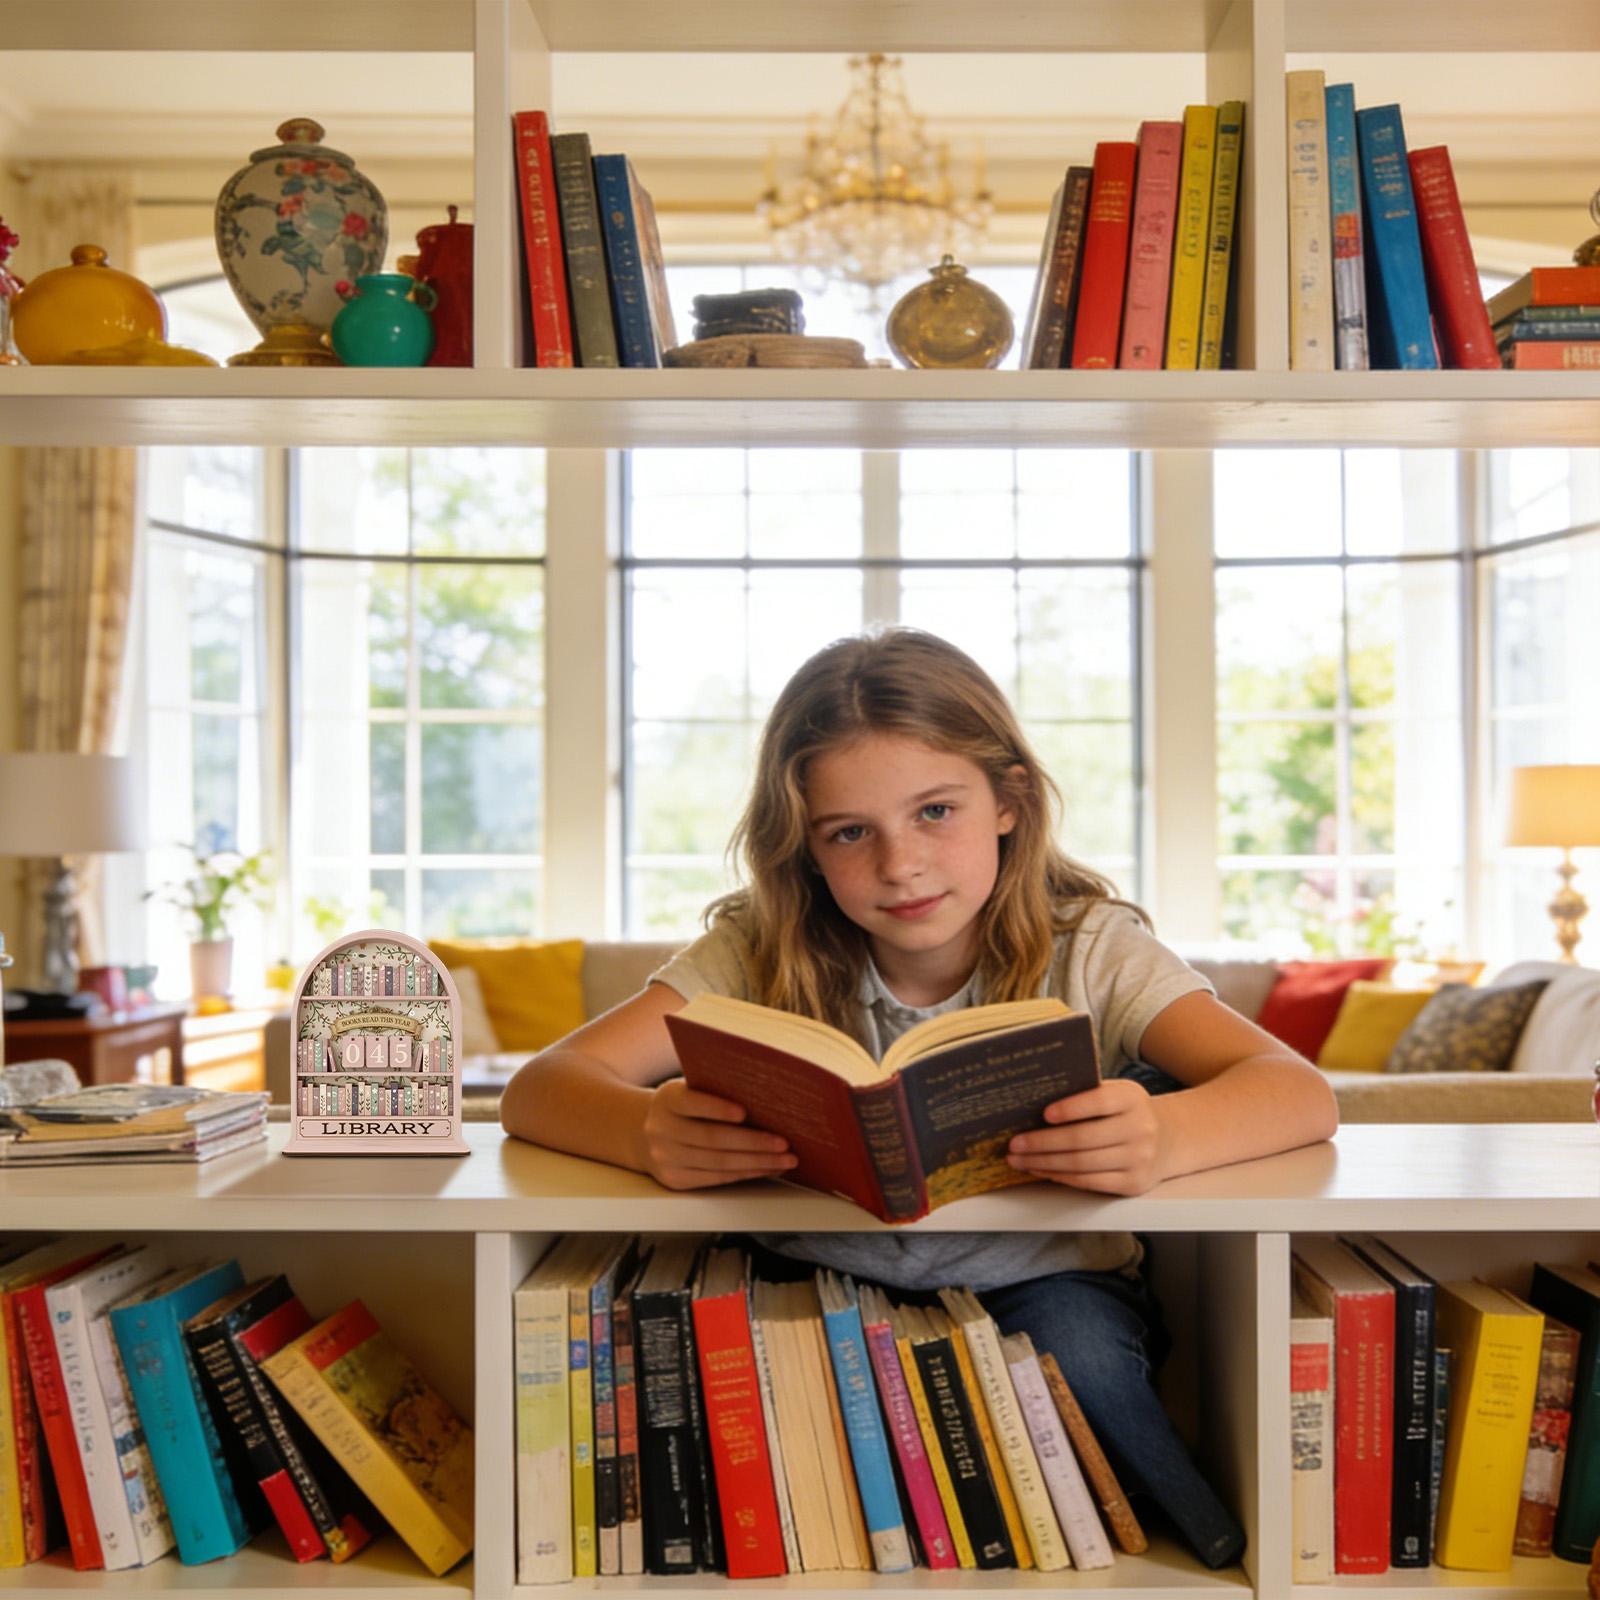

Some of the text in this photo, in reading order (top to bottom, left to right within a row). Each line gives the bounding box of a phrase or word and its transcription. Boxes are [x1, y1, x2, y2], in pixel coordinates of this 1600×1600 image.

[342, 1018, 361, 1027] BOOKS
[394, 1018, 411, 1027] YEAR
[346, 1044, 408, 1064] 045
[322, 1122, 434, 1135] LIBRARY
